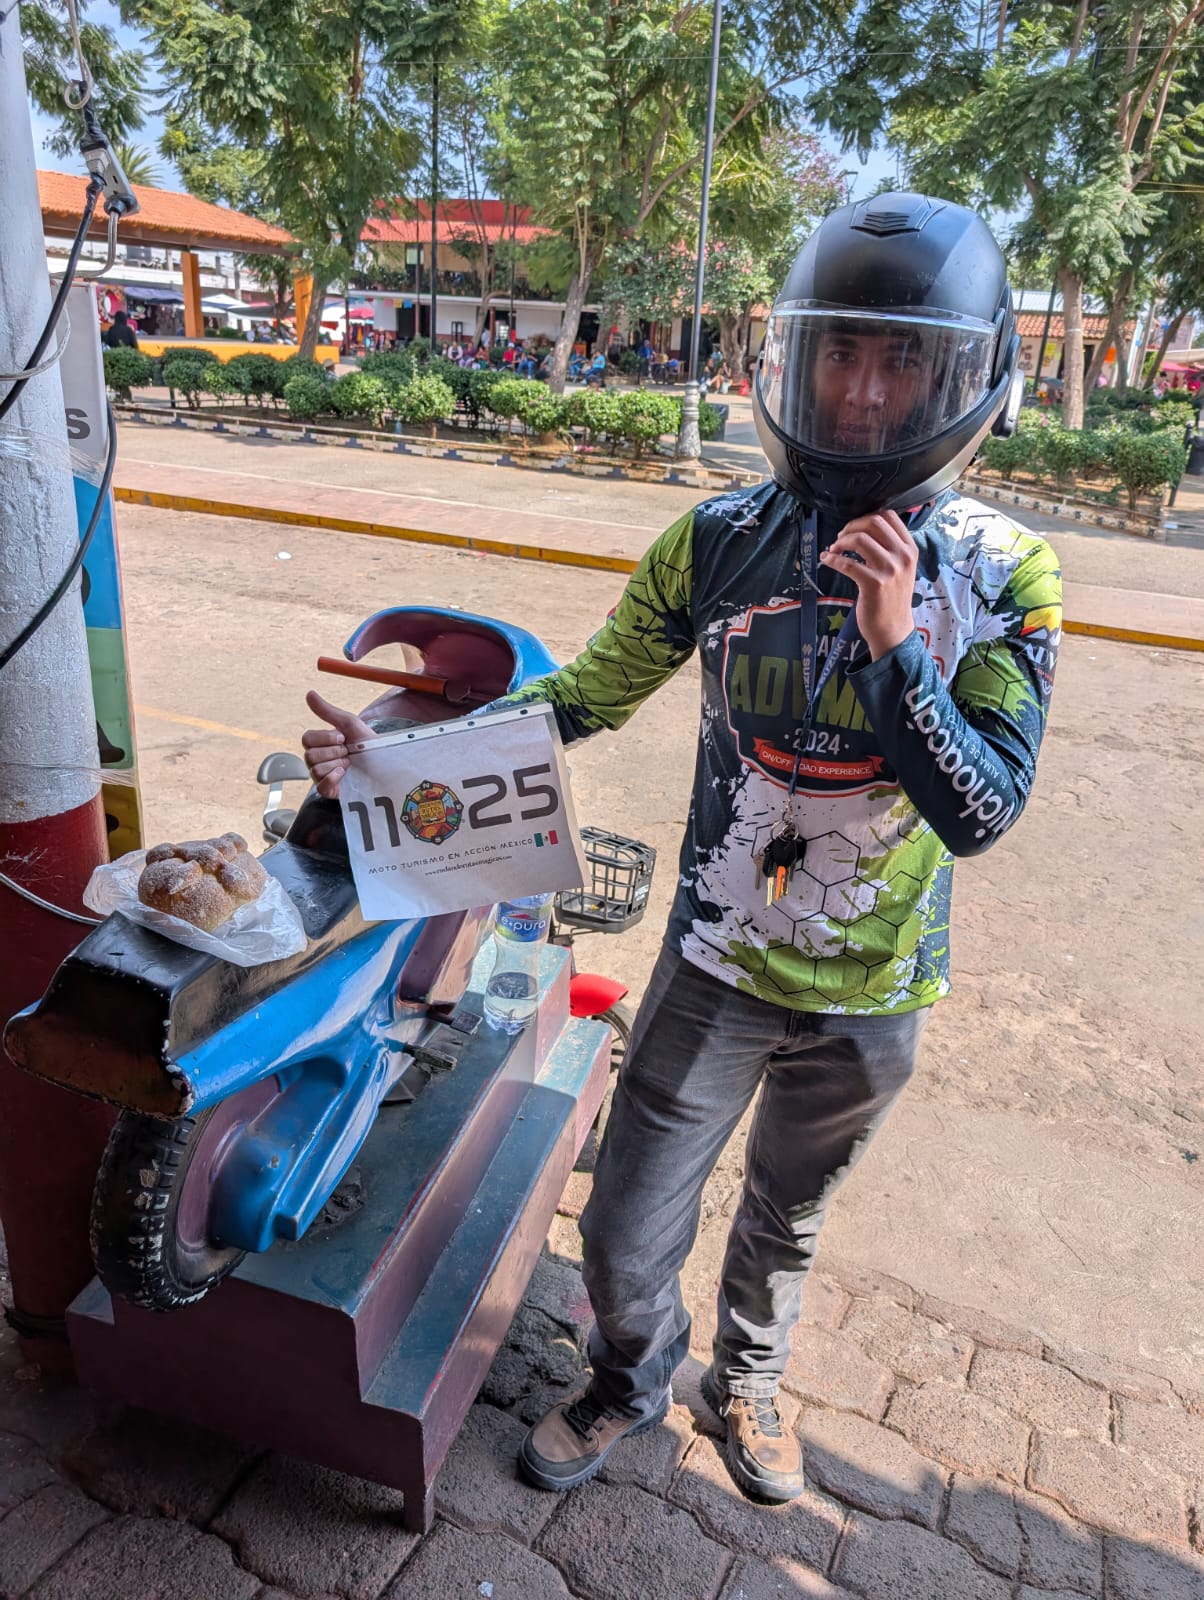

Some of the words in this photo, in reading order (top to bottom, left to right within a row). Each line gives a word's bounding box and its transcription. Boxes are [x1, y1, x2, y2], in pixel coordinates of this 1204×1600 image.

[761, 750, 793, 768] ON/OFF
[799, 763, 818, 773] OAD
[818, 766, 873, 776] EXPERIENCE
[969, 744, 981, 760] DE
[980, 755, 1000, 779] ALMA
[1000, 775, 1008, 790] EL
[368, 864, 398, 875] MOTO
[400, 855, 445, 869] TURISMO
[448, 852, 461, 860] EN
